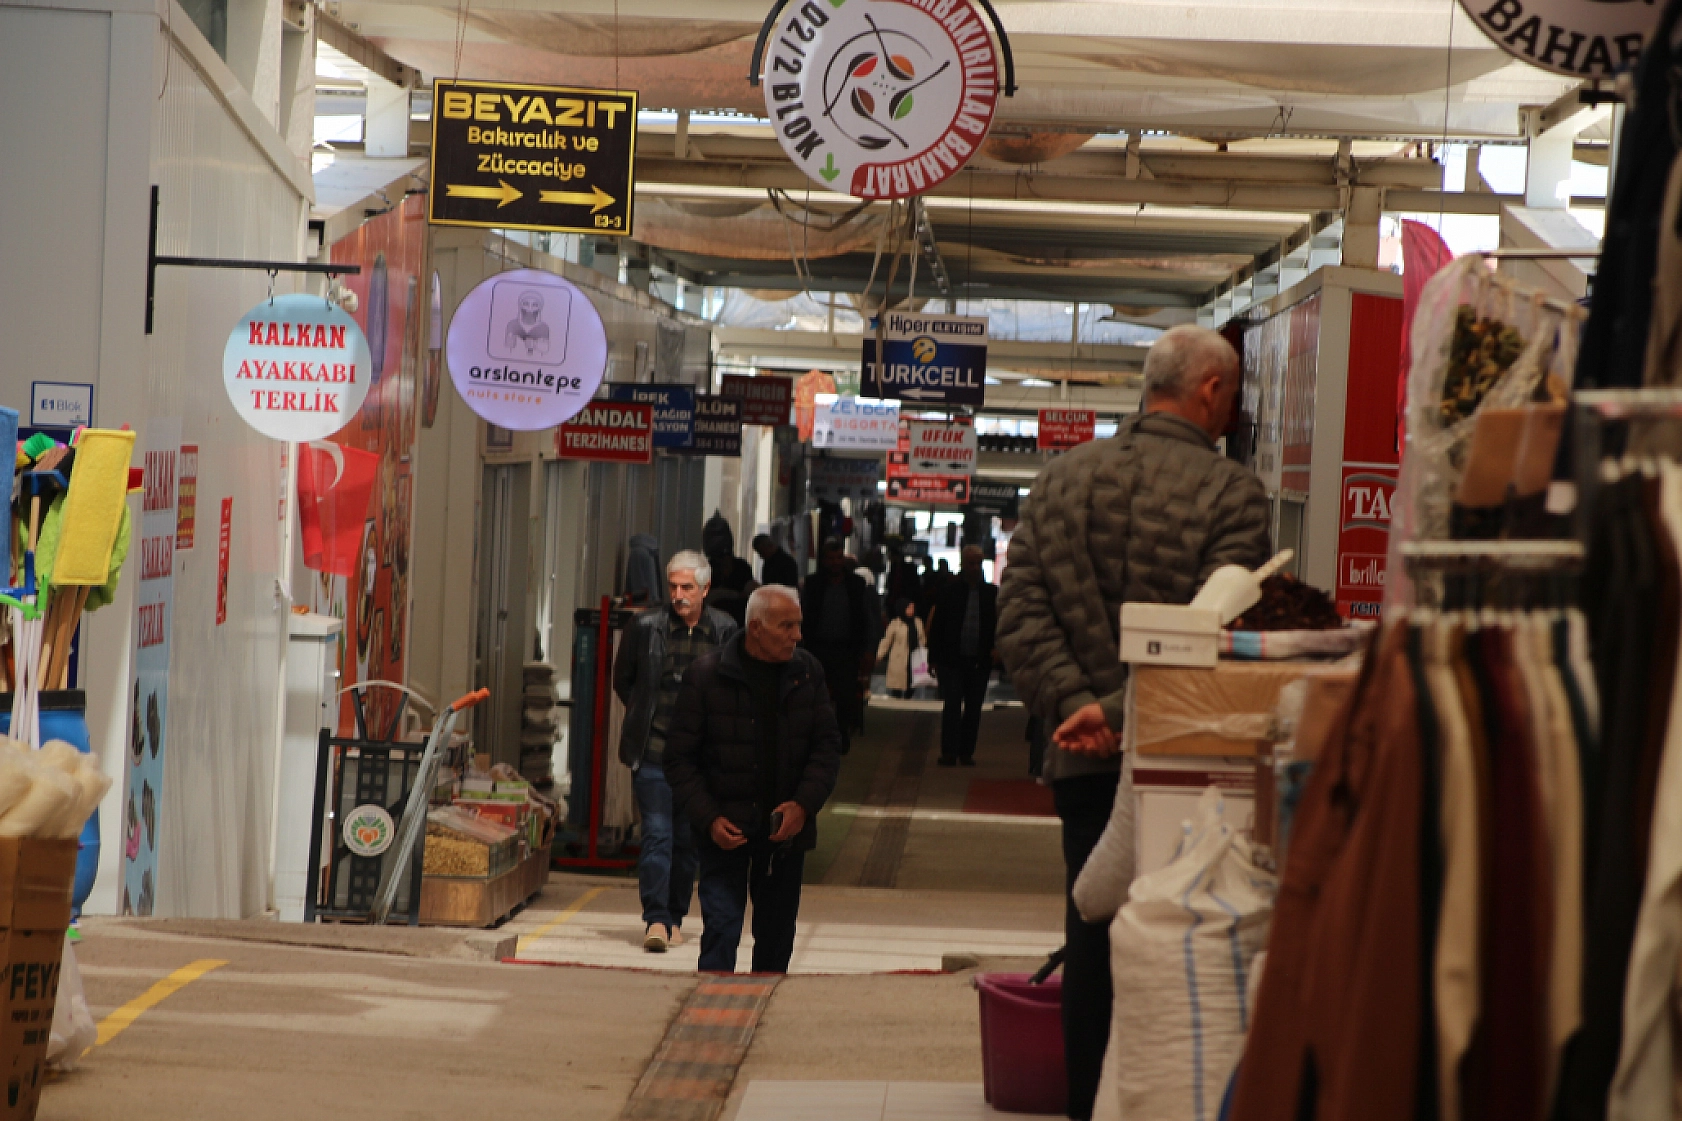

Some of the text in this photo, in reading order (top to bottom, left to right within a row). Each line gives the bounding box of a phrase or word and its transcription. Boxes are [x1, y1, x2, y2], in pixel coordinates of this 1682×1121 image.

[443, 91, 627, 130] BEYAZIT
[772, 82, 825, 161] BLOK
[467, 125, 600, 153] Bakırcılık ve
[477, 153, 586, 182] Züccaciye
[862, 133, 972, 197] BAHARAT
[248, 321, 347, 349] KALKAN
[890, 315, 931, 335] Hiper
[236, 358, 357, 384] AYAKKABI
[468, 364, 582, 395] arslantepe
[866, 362, 980, 388] TURKCELL
[41, 398, 82, 412] E1 Blok
[250, 387, 339, 413] TERLİK
[564, 430, 650, 452] TERZİHANESİ
[921, 429, 965, 444] UFUK
